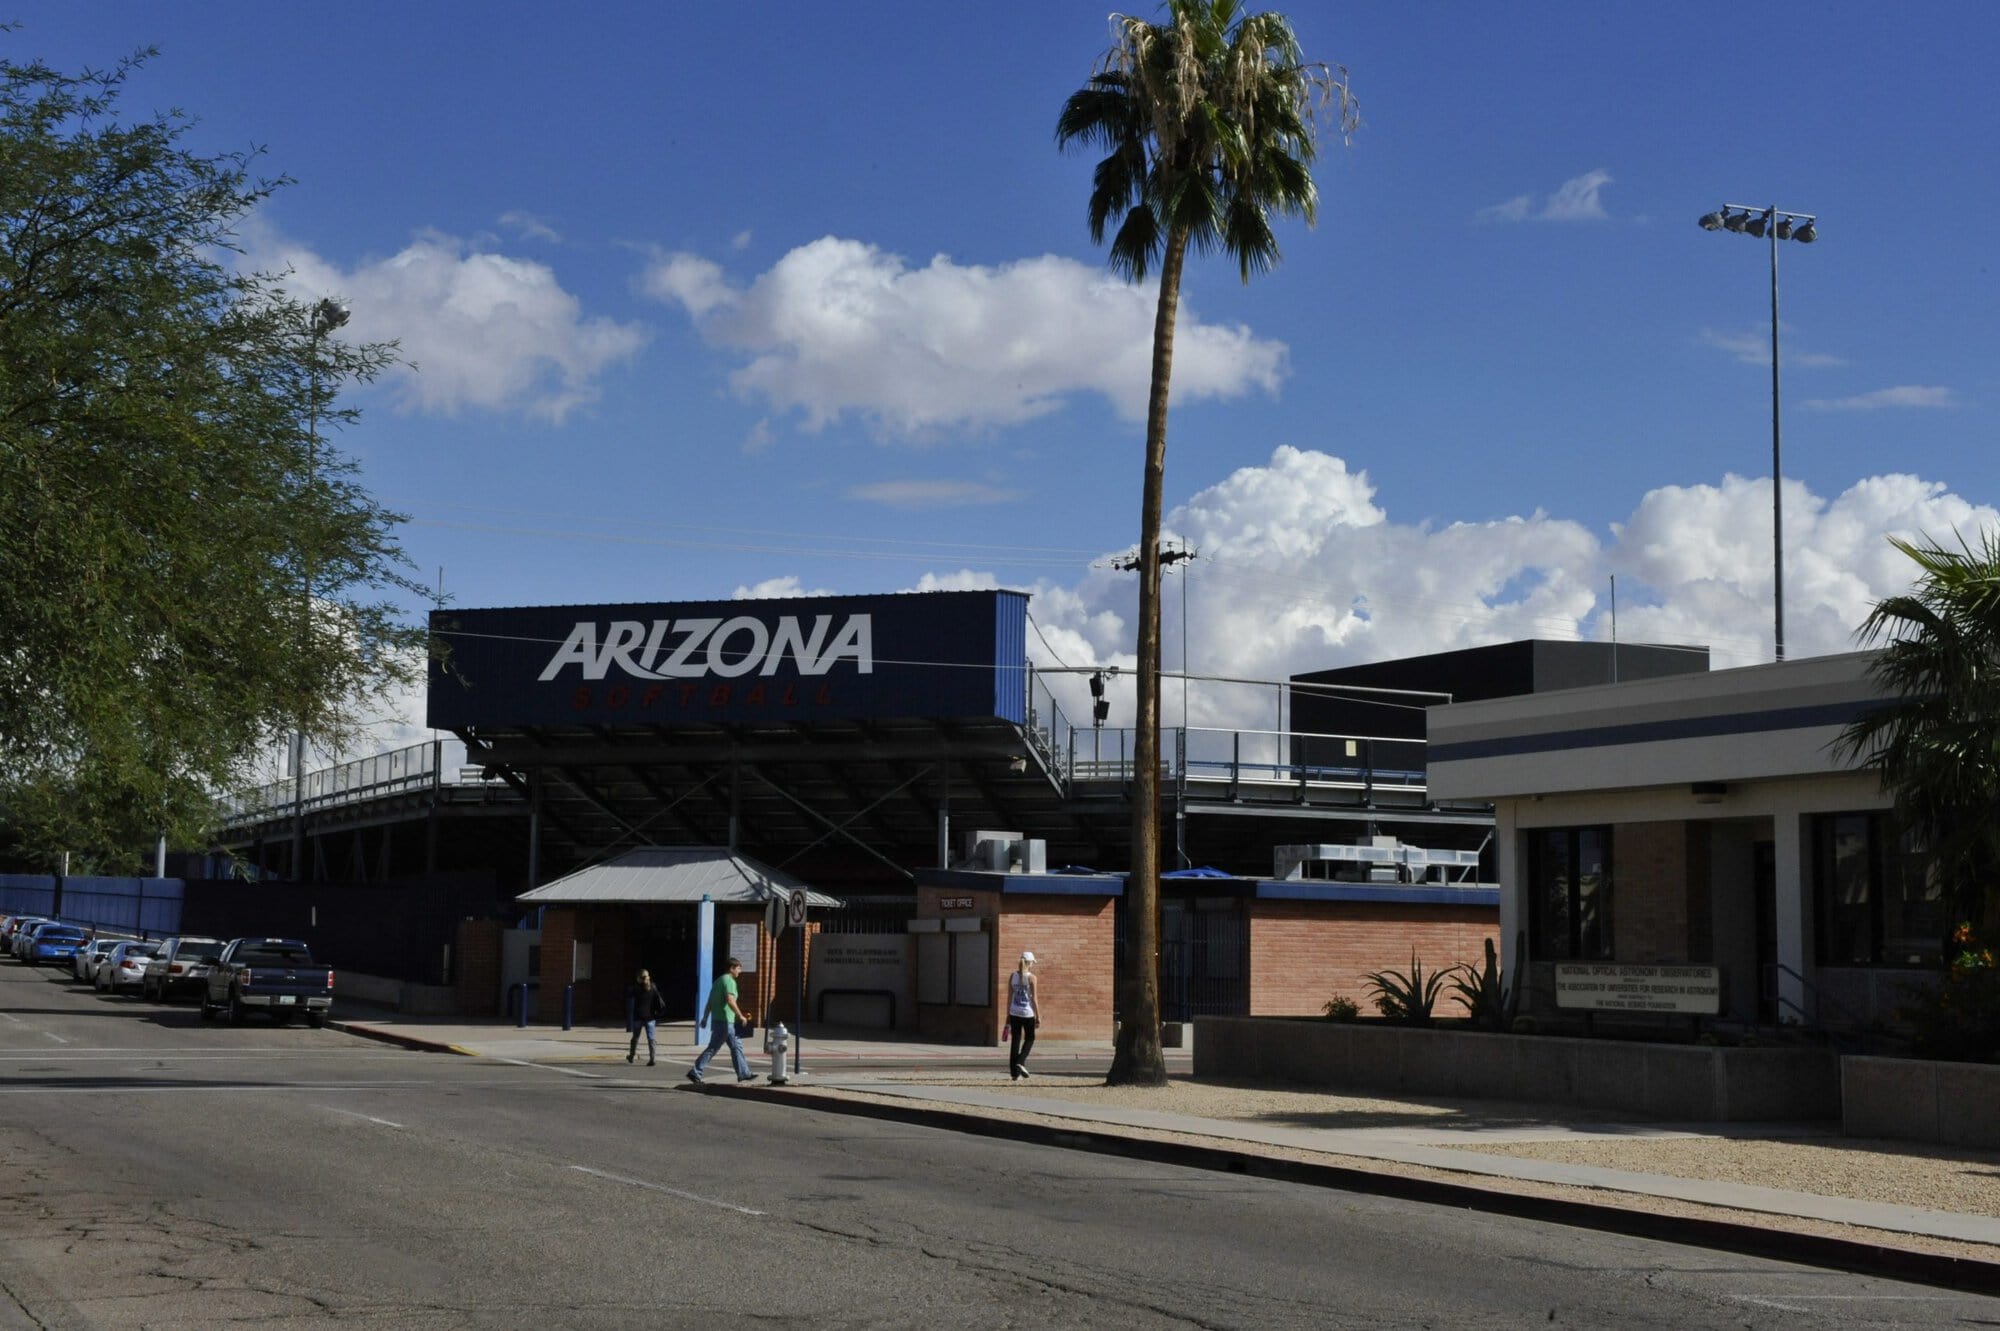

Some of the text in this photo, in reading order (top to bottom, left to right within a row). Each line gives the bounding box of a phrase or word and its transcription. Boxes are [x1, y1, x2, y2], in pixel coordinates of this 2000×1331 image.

[537, 613, 873, 681] ARIZONA
[573, 684, 833, 710] SOFTBALL
[1561, 967, 1591, 976] NATIONAL
[1592, 967, 1617, 976] OPTICAL
[1619, 967, 1658, 977] ASTRONOMY
[1640, 985, 1650, 993] FOR
